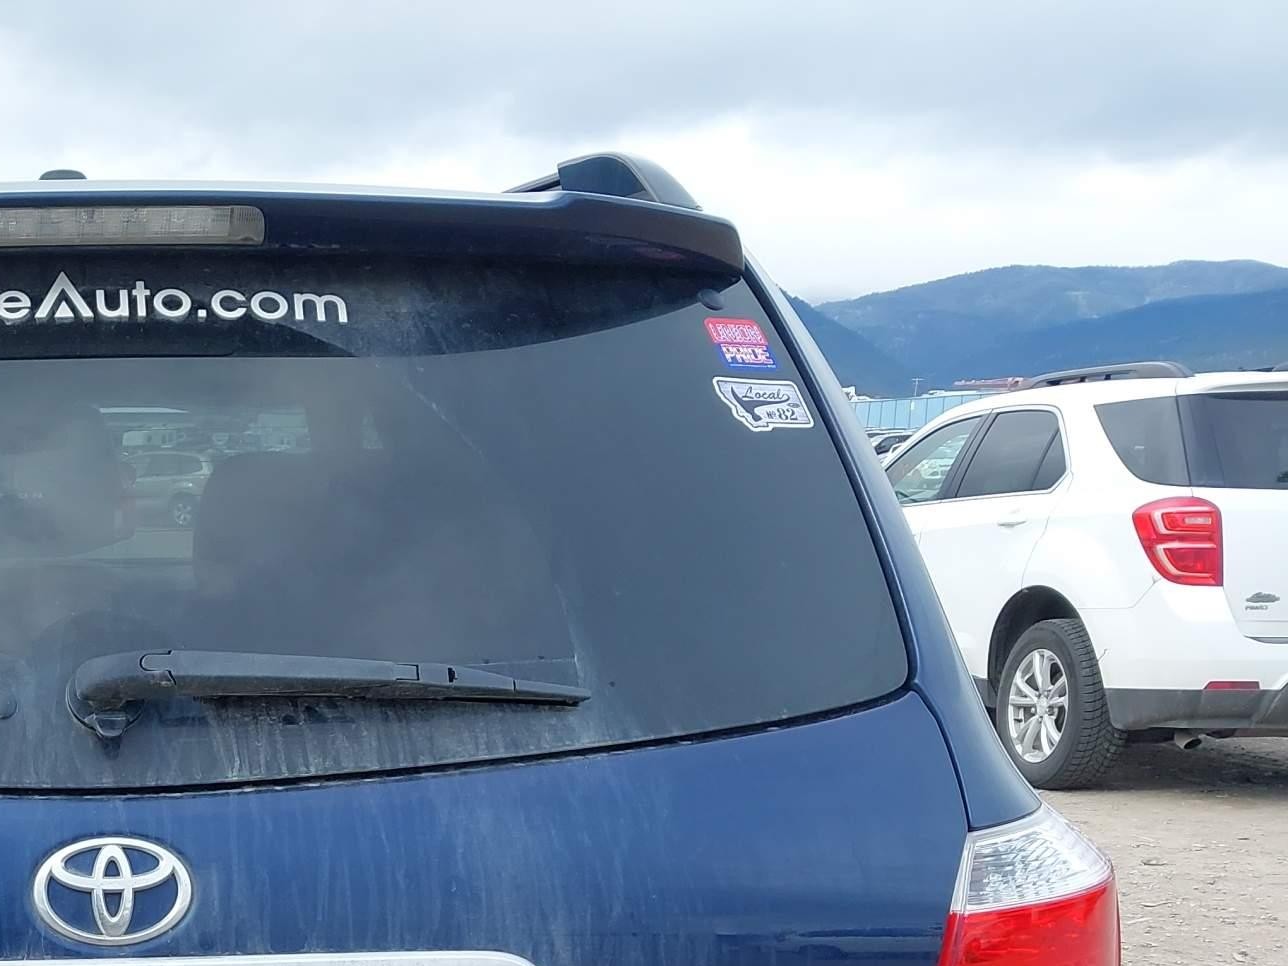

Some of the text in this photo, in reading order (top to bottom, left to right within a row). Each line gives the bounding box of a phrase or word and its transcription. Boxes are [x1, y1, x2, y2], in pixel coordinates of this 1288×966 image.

[720, 343, 774, 364] PRIDE
[742, 386, 789, 400] Local
[777, 407, 798, 421] 82
